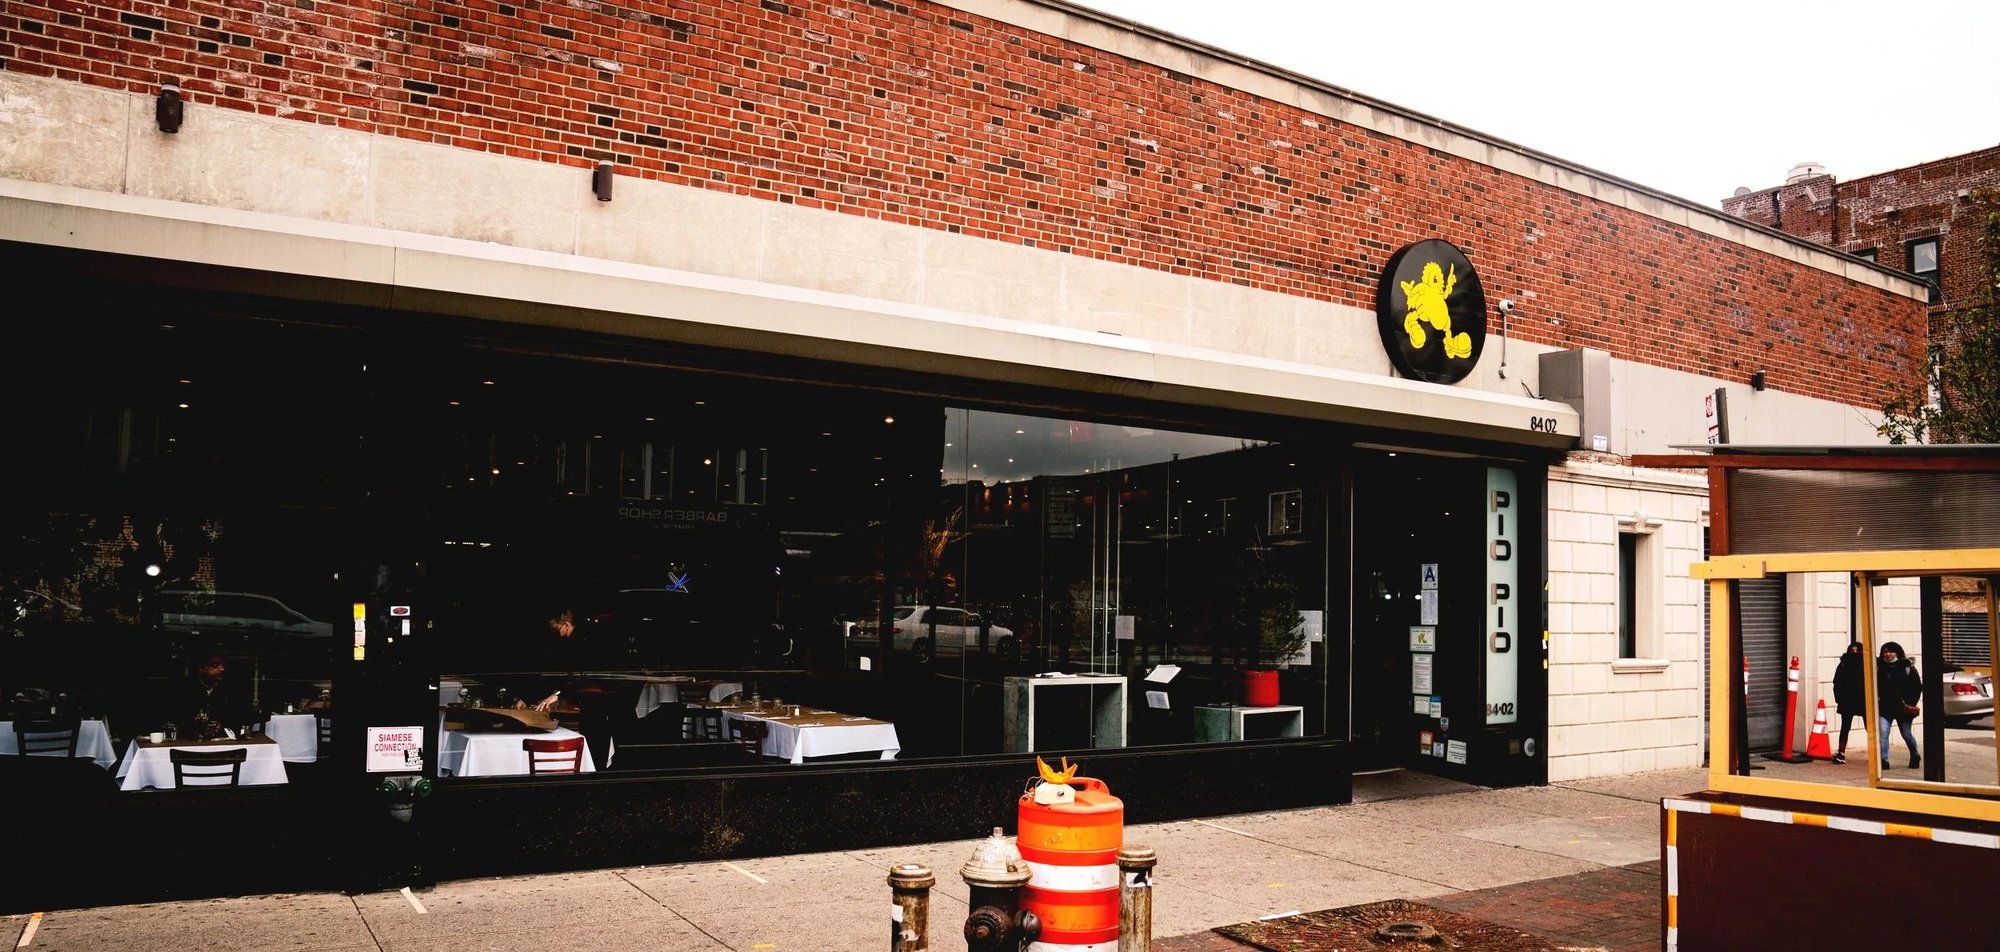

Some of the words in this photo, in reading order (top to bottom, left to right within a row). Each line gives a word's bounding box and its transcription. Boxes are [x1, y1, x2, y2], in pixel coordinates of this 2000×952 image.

[1490, 490, 1511, 561] PIO
[1424, 566, 1435, 583] A
[1490, 583, 1511, 653] PIO
[378, 733, 413, 742] SIAMESE
[374, 743, 417, 752] CONNECTION
